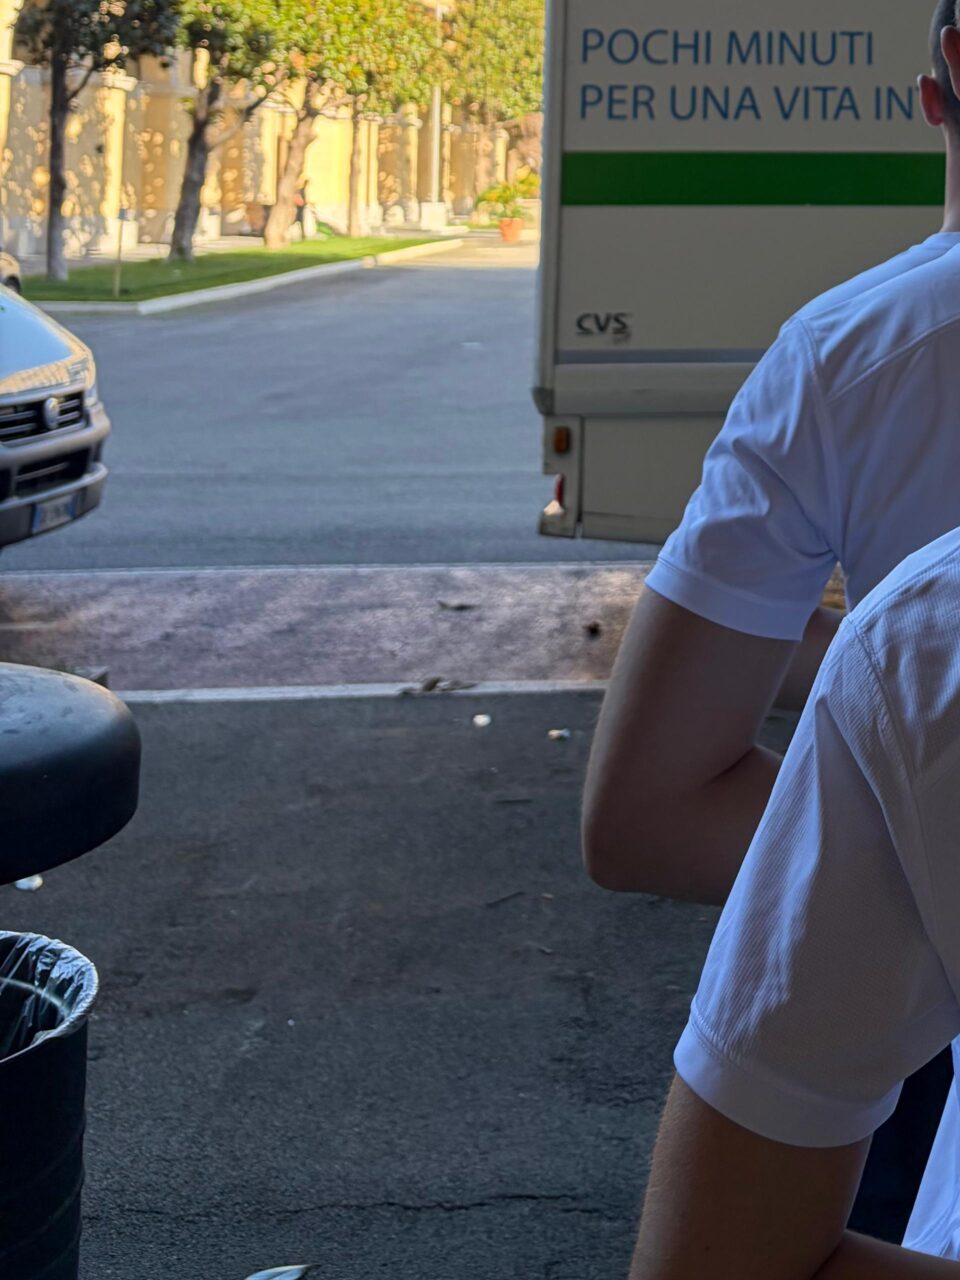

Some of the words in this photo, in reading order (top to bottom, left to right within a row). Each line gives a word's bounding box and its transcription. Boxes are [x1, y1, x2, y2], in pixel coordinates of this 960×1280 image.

[581, 29, 712, 66] POCHI
[726, 31, 874, 66] MINUTI
[580, 84, 656, 121] PER
[670, 85, 761, 121] UNA
[773, 86, 860, 120] VITA
[874, 86, 918, 120] IN
[576, 312, 632, 342] CVS
